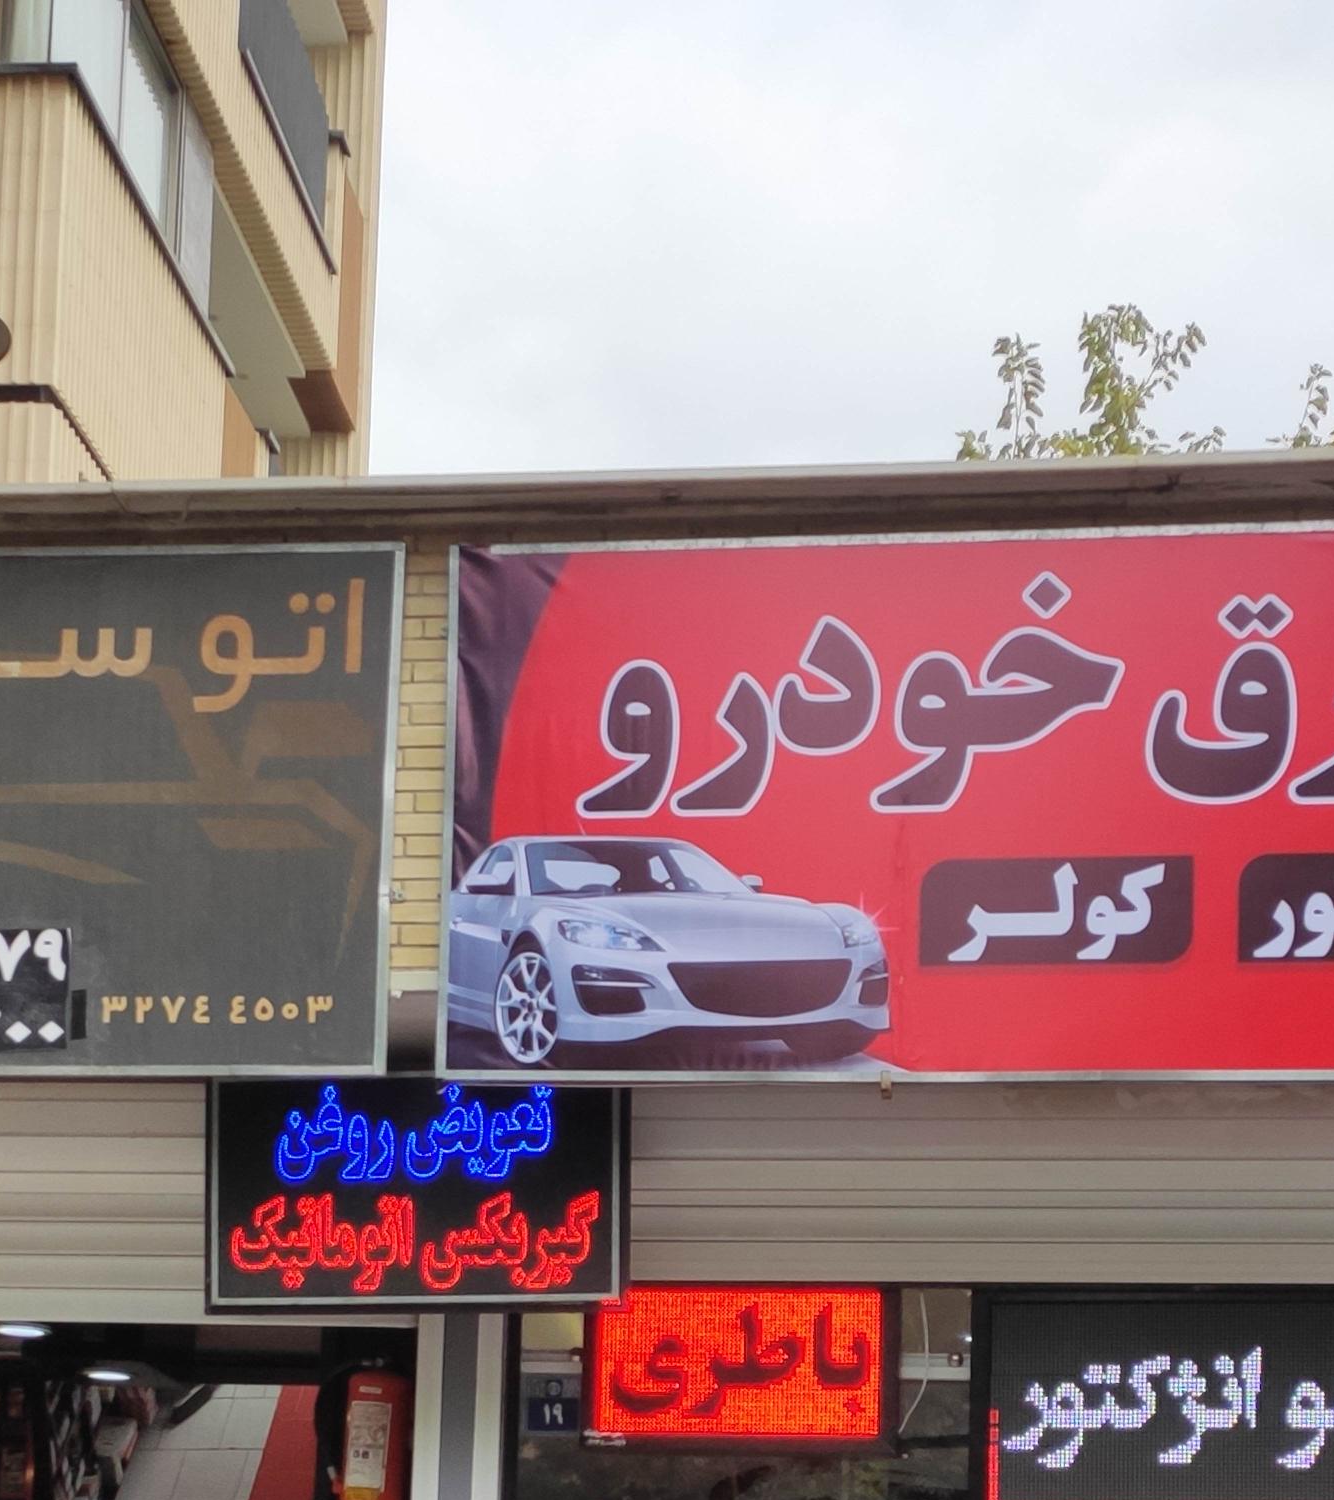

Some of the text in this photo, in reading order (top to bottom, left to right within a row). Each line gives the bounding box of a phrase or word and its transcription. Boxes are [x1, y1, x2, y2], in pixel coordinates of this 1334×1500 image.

[193, 578, 365, 713] اتو
[576, 570, 1126, 818] خودرو
[947, 861, 1165, 961] کولر
[276, 1084, 555, 1181] تعویض روغن
[230, 1190, 600, 1292] گیربکس اتوماتیک
[610, 1302, 871, 1417] باطری
[1002, 1346, 1262, 1469] انژکتور
